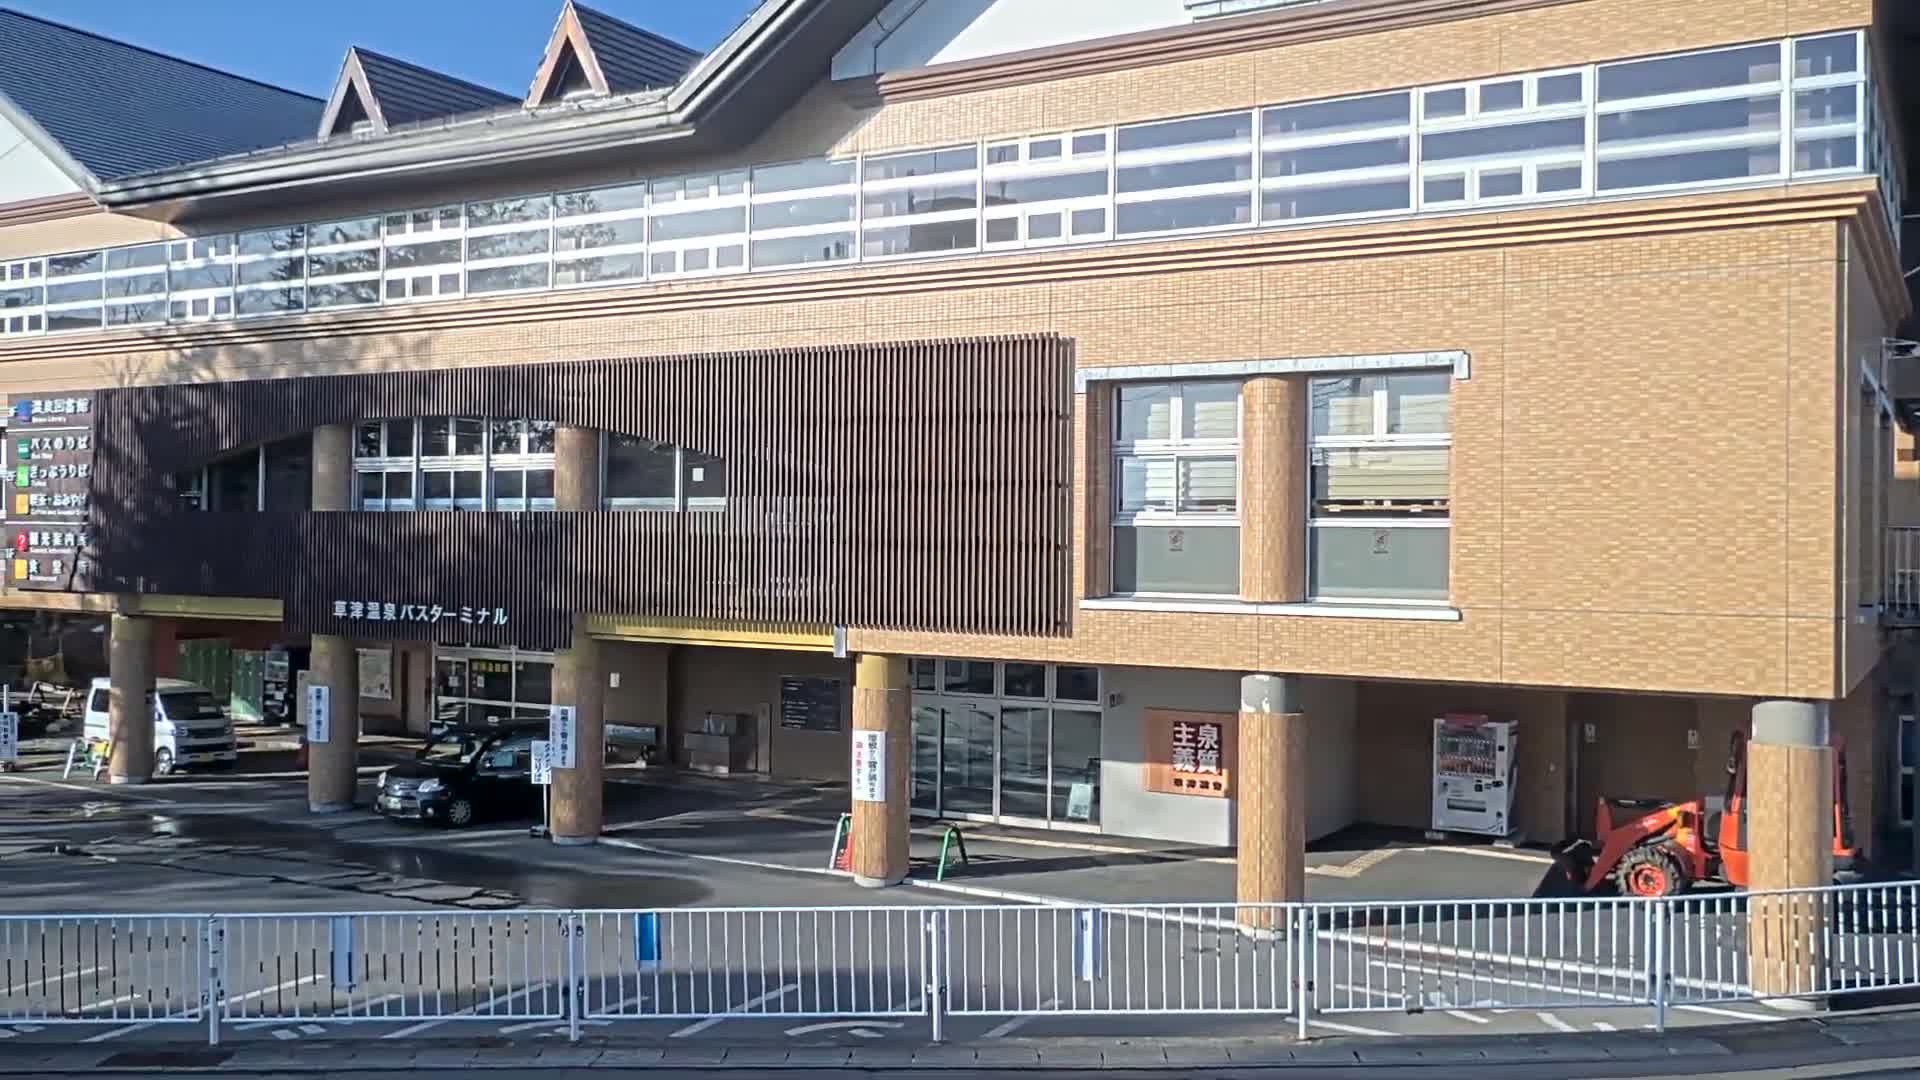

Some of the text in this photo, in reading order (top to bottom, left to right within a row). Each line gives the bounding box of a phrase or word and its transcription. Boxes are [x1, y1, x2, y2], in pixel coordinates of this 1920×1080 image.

[31, 436, 88, 449] バスのりば
[30, 464, 87, 478] きっぷうりば
[333, 601, 507, 625] 草津温泉バスターミナル
[1197, 724, 1219, 774] 泉質
